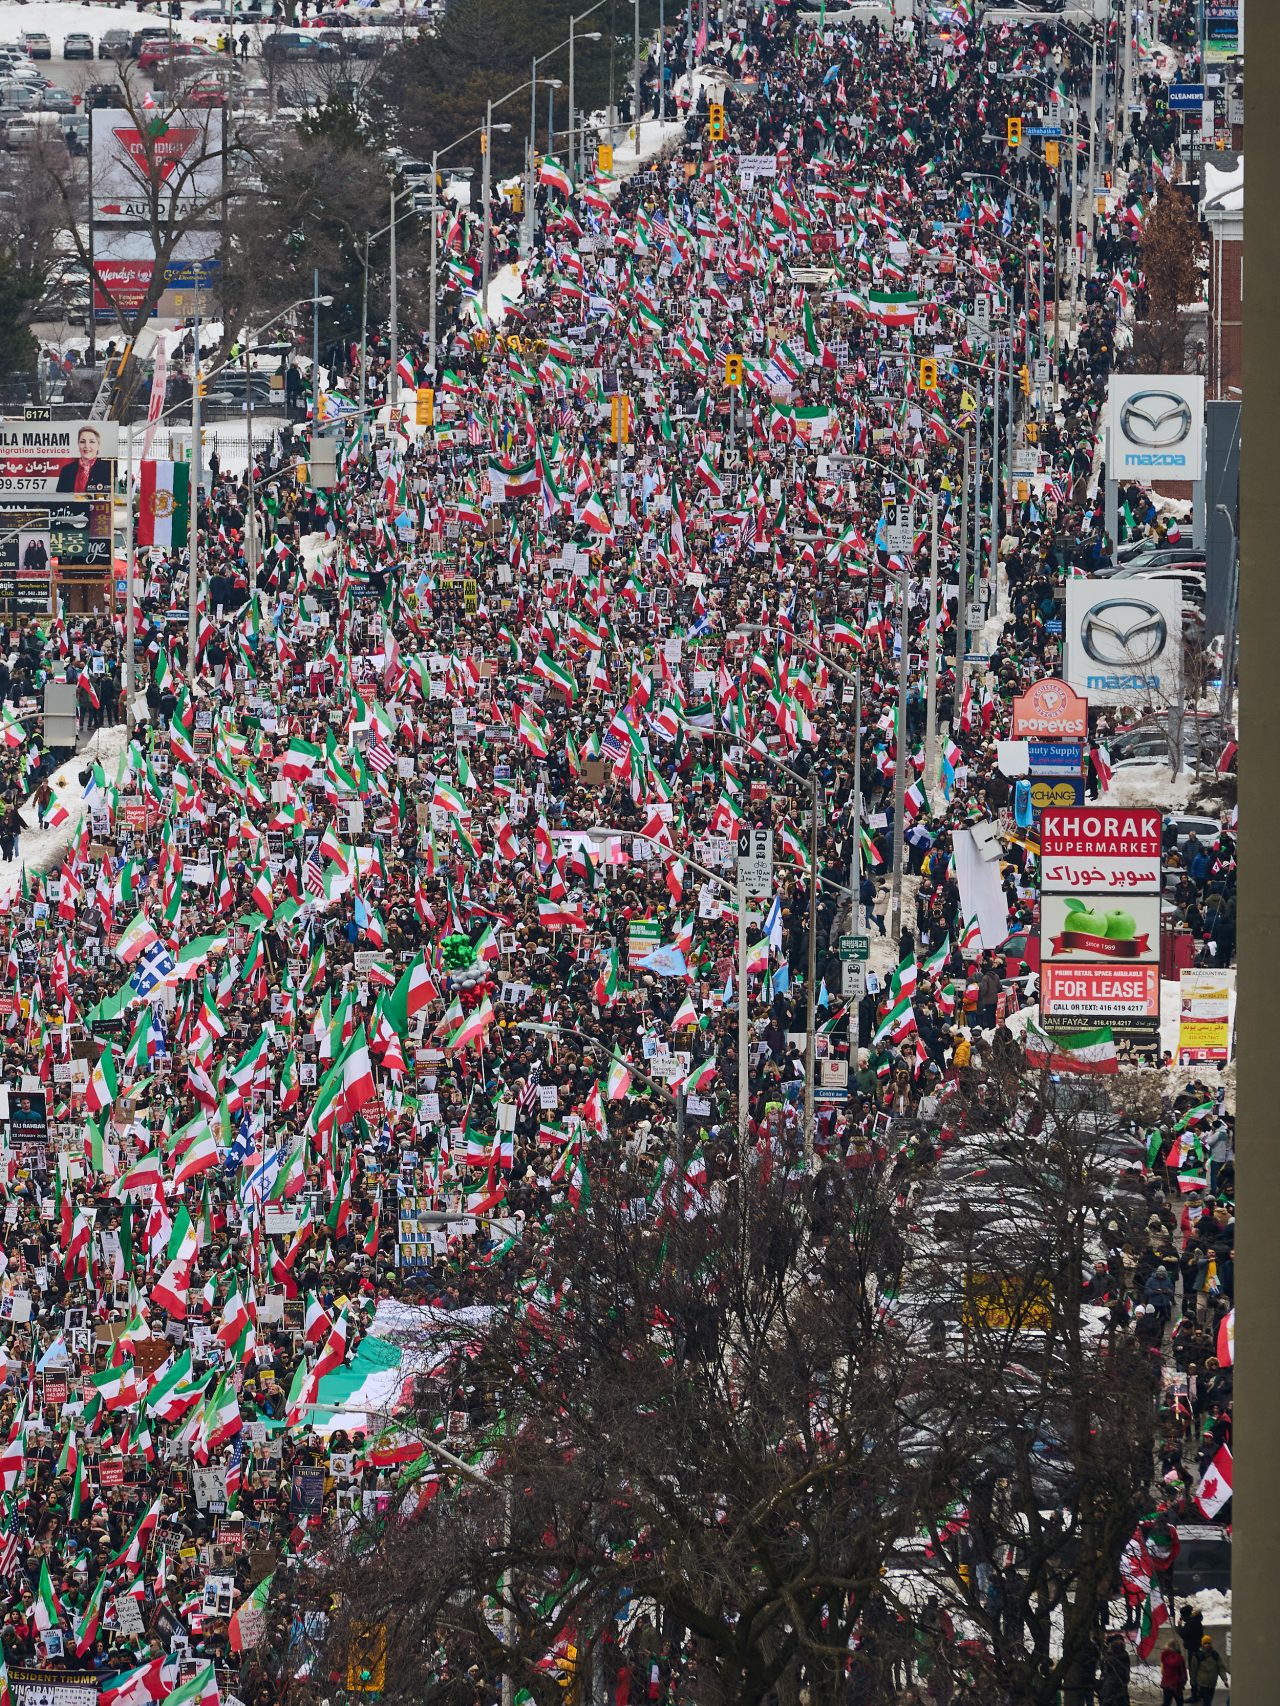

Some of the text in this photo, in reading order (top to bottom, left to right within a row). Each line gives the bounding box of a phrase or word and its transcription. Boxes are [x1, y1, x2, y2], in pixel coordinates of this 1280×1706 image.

[98, 269, 135, 283] Wendy's
[26, 410, 50, 419] 6174
[23, 433, 70, 446] MAHAM
[1125, 454, 1185, 466] mazda
[25, 462, 59, 474] سازمان
[1050, 747, 1080, 757] Supply
[1031, 791, 1076, 801] XCHANGE
[1044, 817, 1157, 837] KHORAK
[1045, 842, 1158, 852] SUPERMARKET
[1045, 865, 1157, 887] سوپر خوراک
[1055, 980, 1144, 998] FOR LEASE
[1127, 1004, 1143, 1012] 4217
[1043, 1018, 1060, 1026] SAM
[1062, 1018, 1089, 1026] FAYAZ
[170, 1531, 181, 1541] TO
[9, 1671, 99, 1686] RESIDENT TRUMP,
